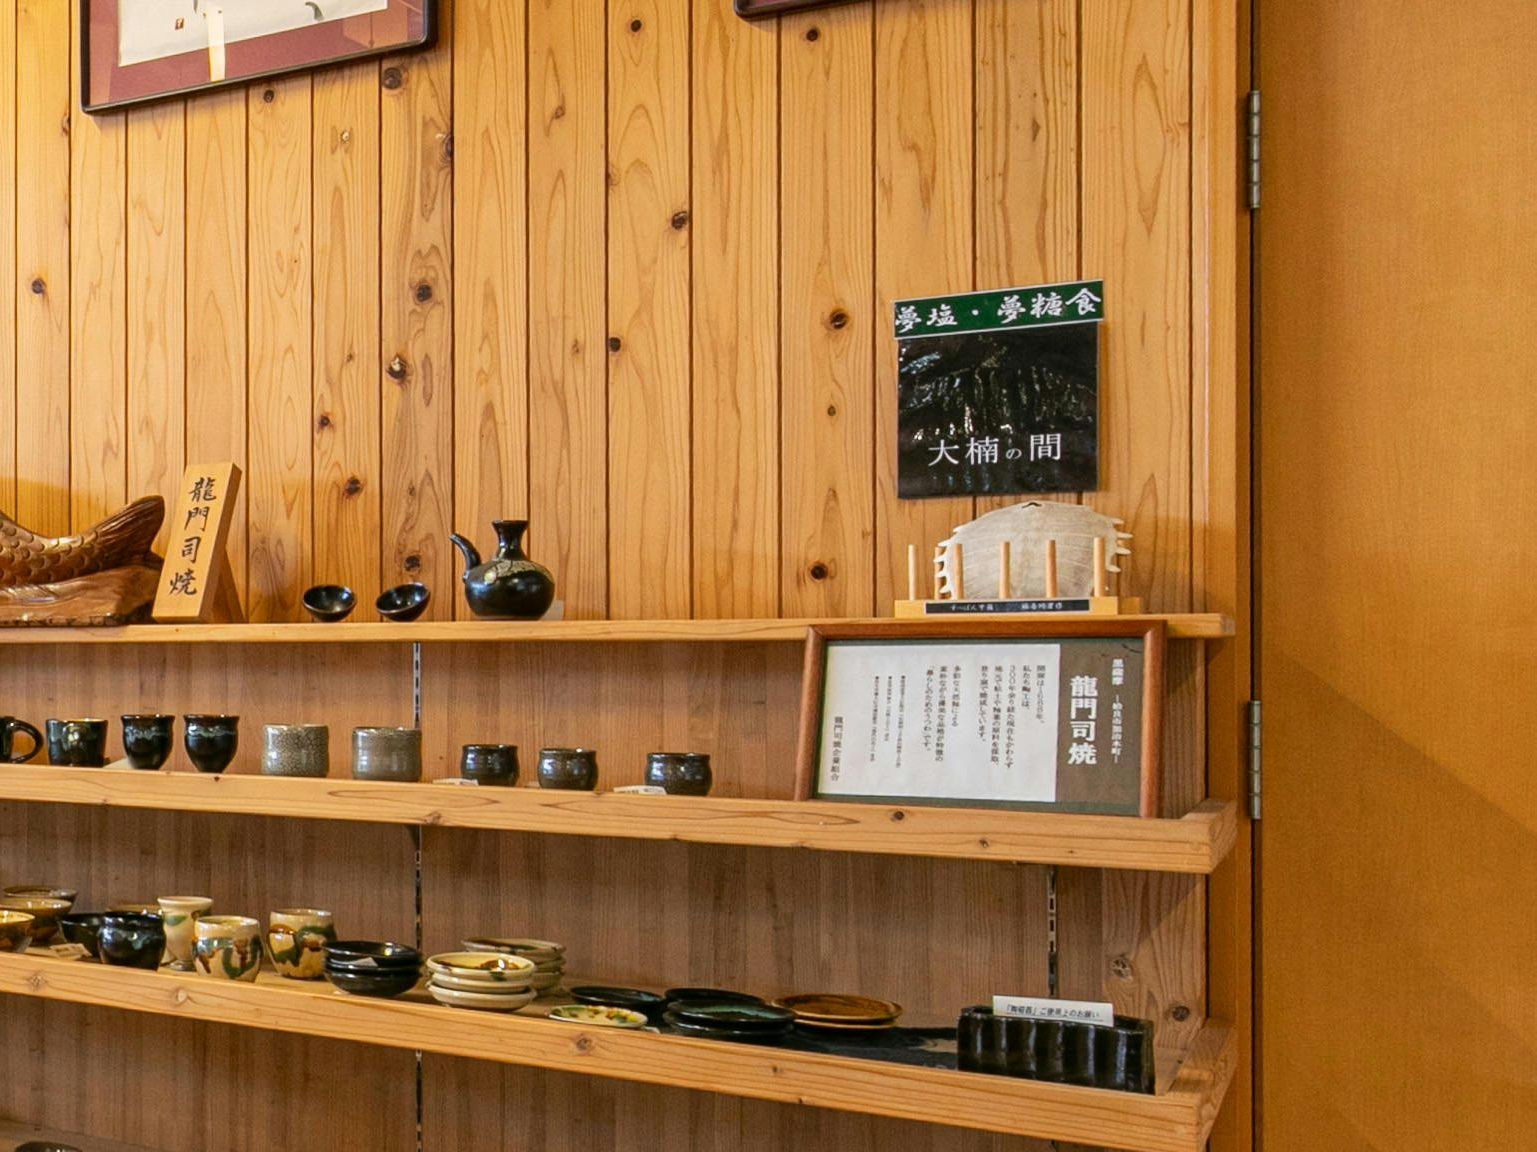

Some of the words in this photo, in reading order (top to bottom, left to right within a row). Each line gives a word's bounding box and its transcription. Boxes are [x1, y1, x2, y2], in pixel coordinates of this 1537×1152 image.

[927, 433, 1062, 467] 大楠の間
[168, 477, 217, 596] 龍門司焼
[1068, 675, 1098, 764] 龍門司焼
